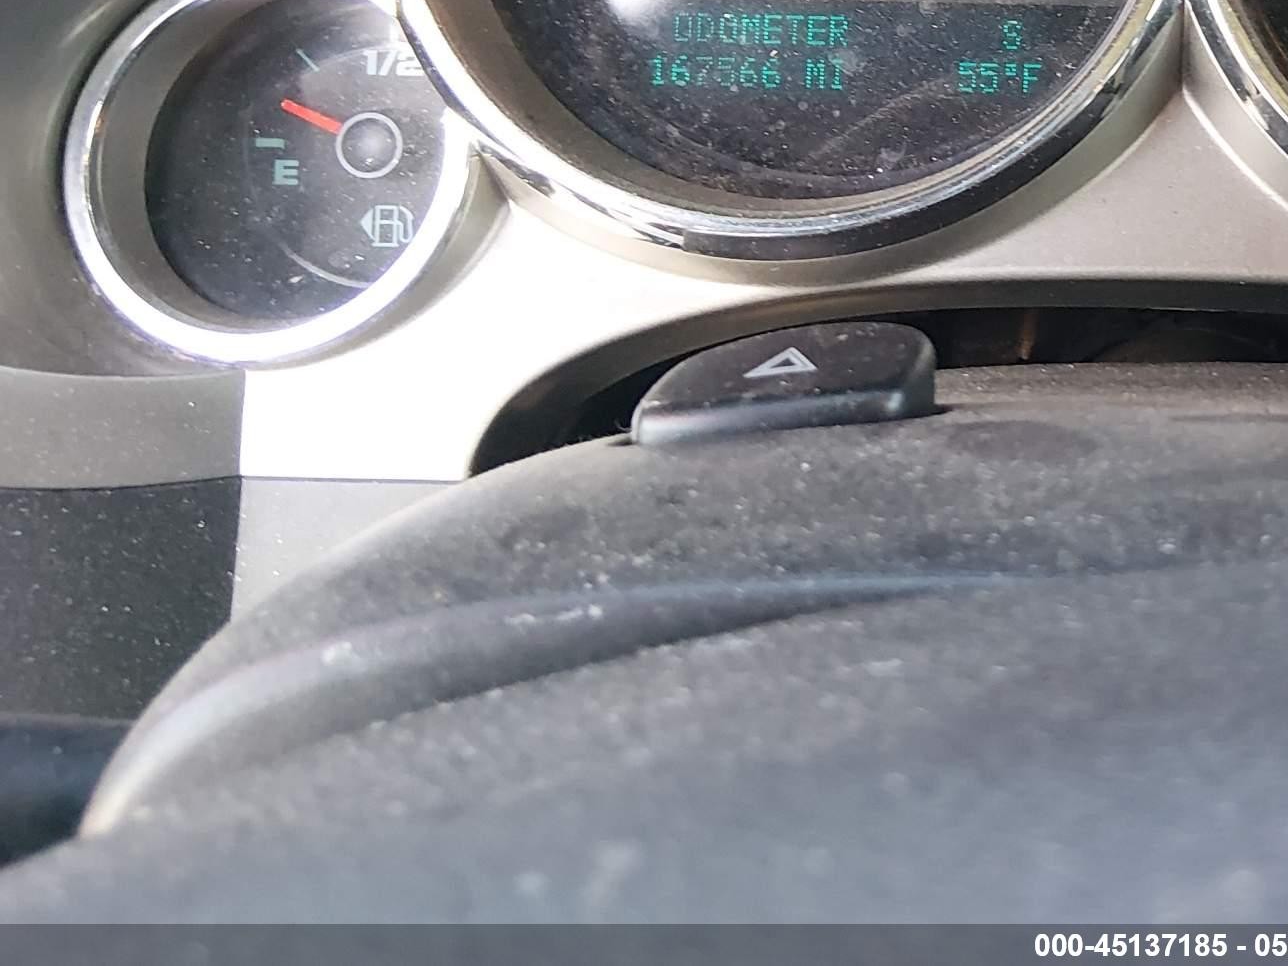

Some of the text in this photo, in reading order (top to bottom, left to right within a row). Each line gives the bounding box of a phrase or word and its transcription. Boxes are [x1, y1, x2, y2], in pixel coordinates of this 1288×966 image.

[673, 12, 849, 47] ODOMETER
[363, 50, 424, 76] 1/2
[804, 56, 843, 91] MI
[273, 160, 299, 185] E
